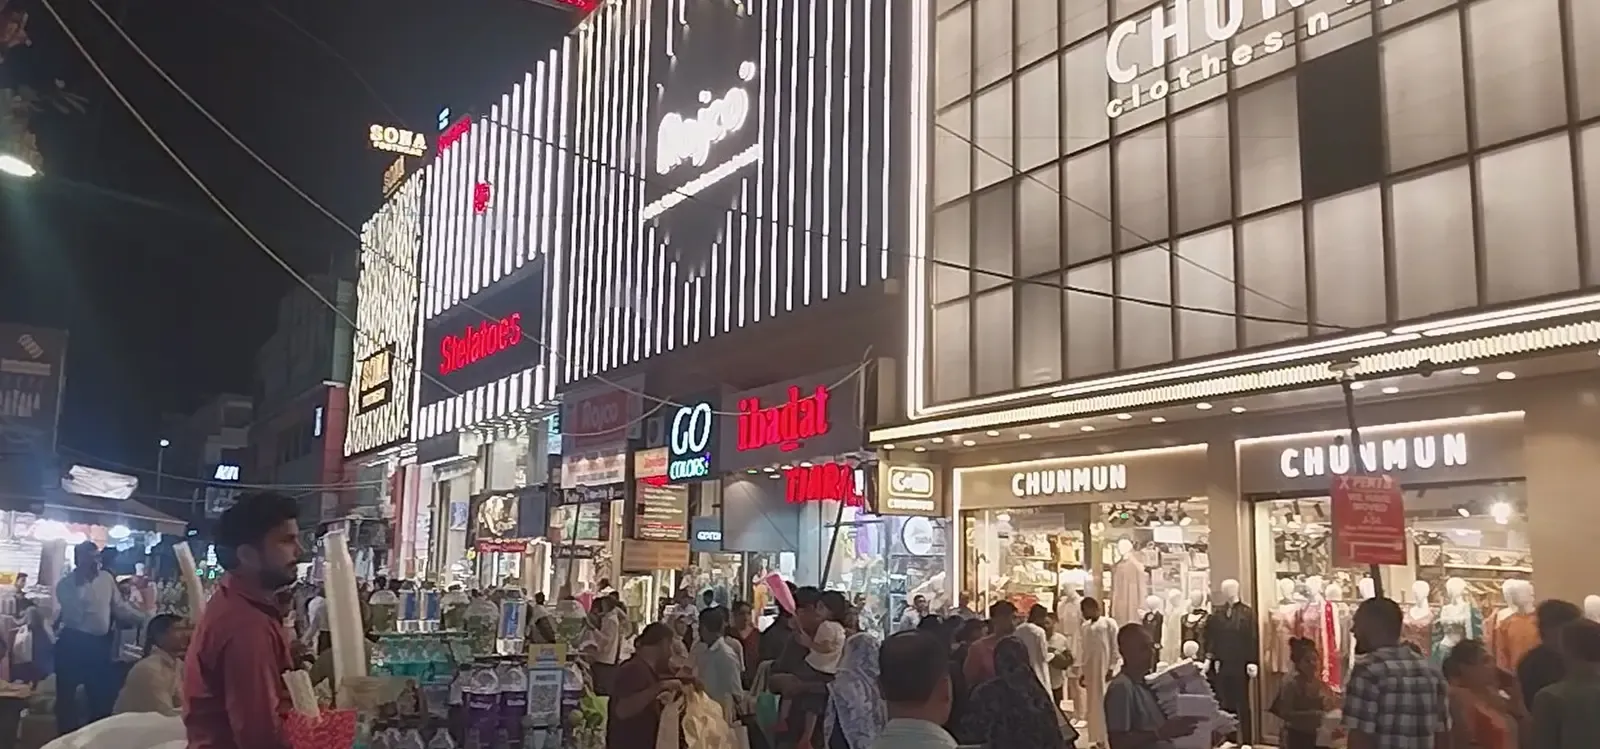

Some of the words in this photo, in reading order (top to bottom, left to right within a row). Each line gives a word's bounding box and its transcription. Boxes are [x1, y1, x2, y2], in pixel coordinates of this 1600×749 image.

[1106, 31, 1284, 118] clothes
[439, 312, 521, 375] Stelatoes
[671, 403, 712, 455] GO
[738, 384, 829, 451] ibadat
[1012, 464, 1127, 497] CHUNMUN
